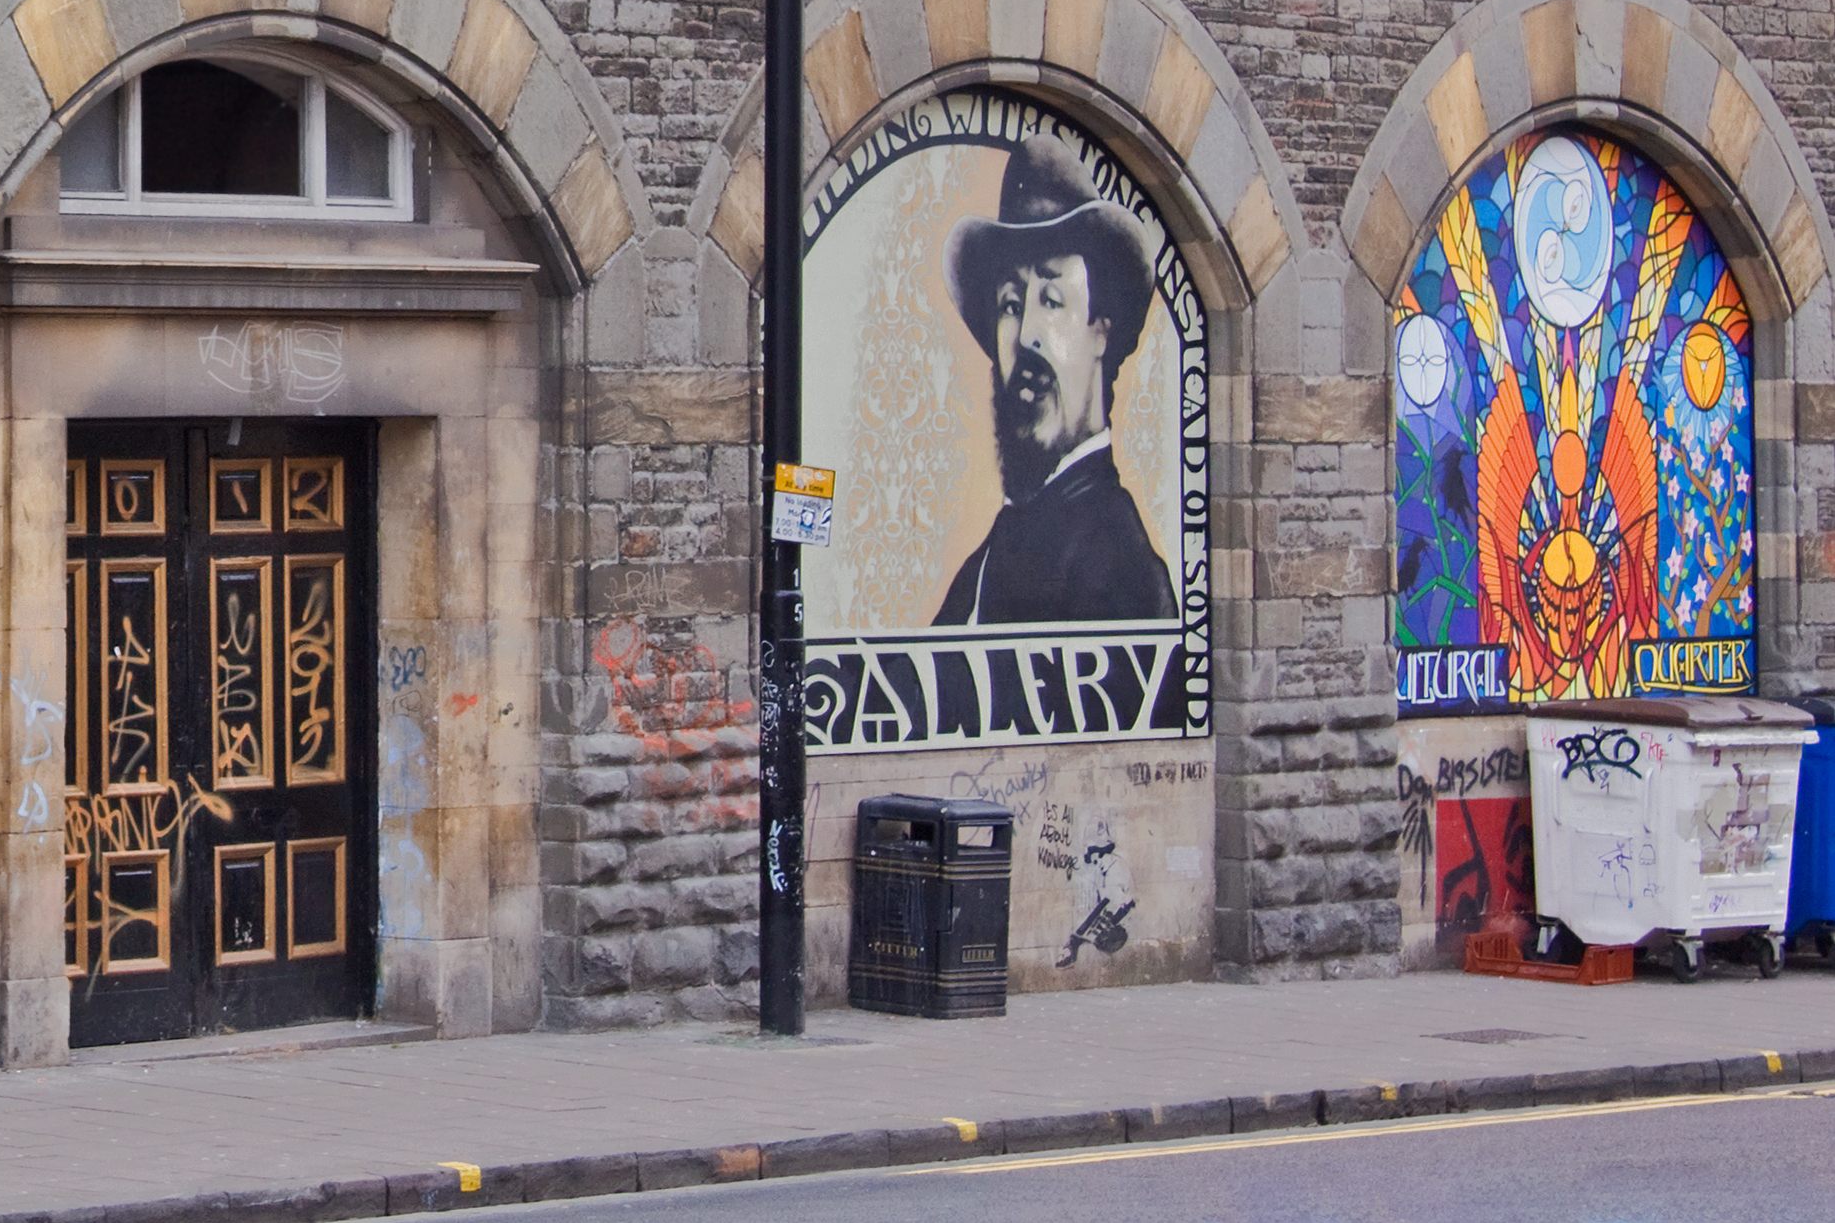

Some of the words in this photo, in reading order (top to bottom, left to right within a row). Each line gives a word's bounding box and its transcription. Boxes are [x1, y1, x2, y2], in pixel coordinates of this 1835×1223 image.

[809, 484, 824, 493] time
[1395, 648, 1507, 707] ULTURAL
[1634, 639, 1755, 694] QUARTER
